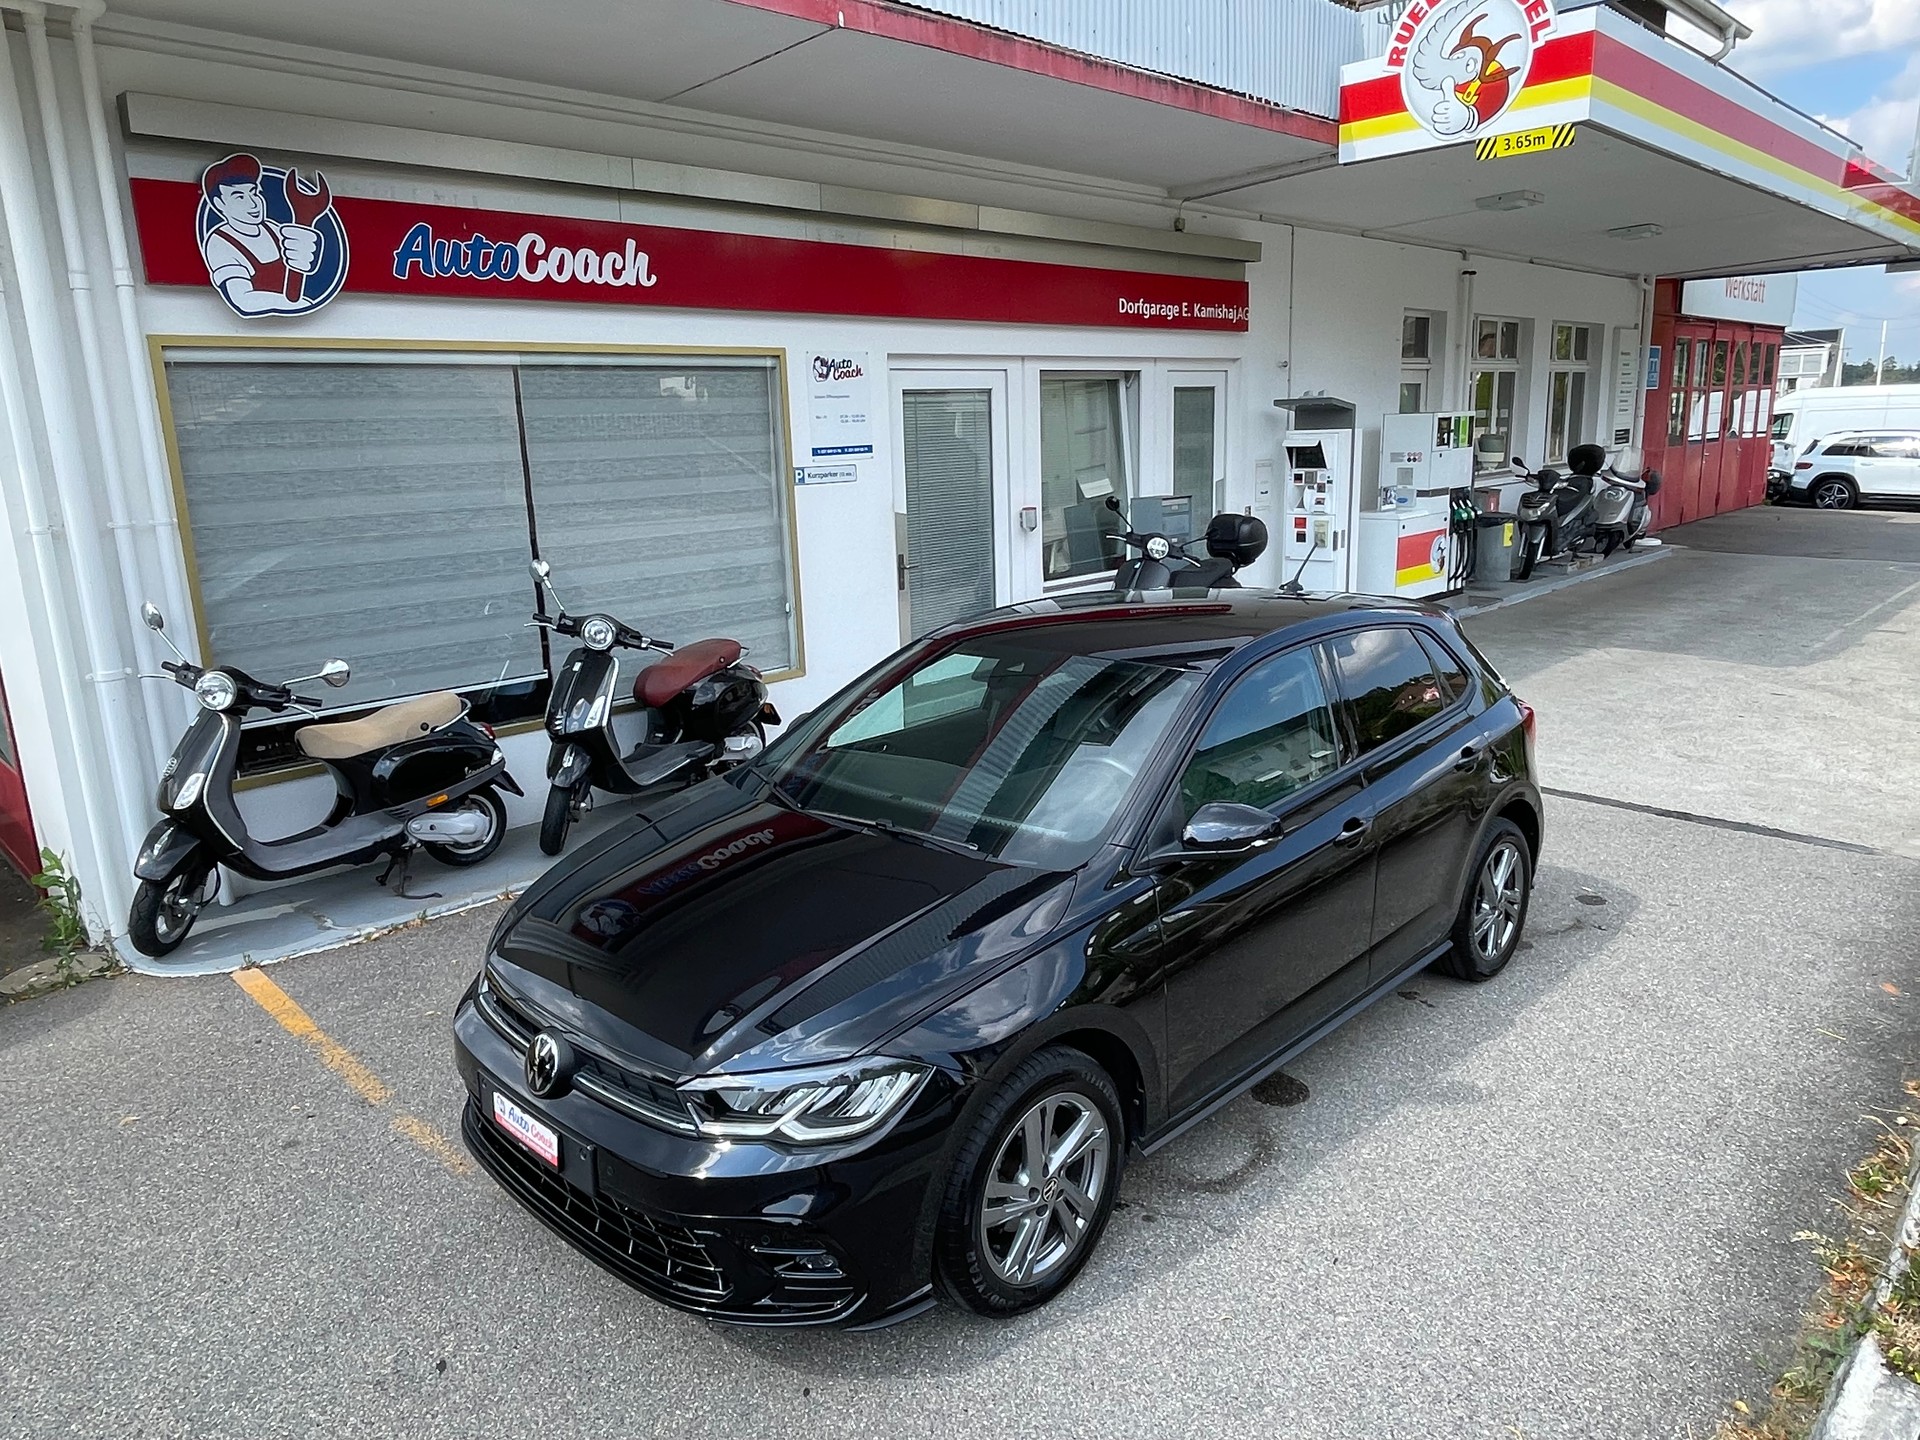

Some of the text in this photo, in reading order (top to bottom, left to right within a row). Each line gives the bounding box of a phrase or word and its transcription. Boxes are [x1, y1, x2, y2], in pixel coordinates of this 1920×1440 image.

[1516, 0, 1551, 43] EL
[1503, 136, 1545, 151] 3.65m
[393, 222, 657, 287] AutoCoach
[1725, 277, 1766, 303] Werkstatt
[1118, 297, 1180, 320] Dorfgarage
[1182, 302, 1192, 317] E.
[1194, 303, 1237, 323] Kamishaj
[829, 358, 853, 370] Auto
[833, 365, 864, 381] Coach
[795, 469, 804, 484] P
[807, 471, 838, 480] Kurzparker
